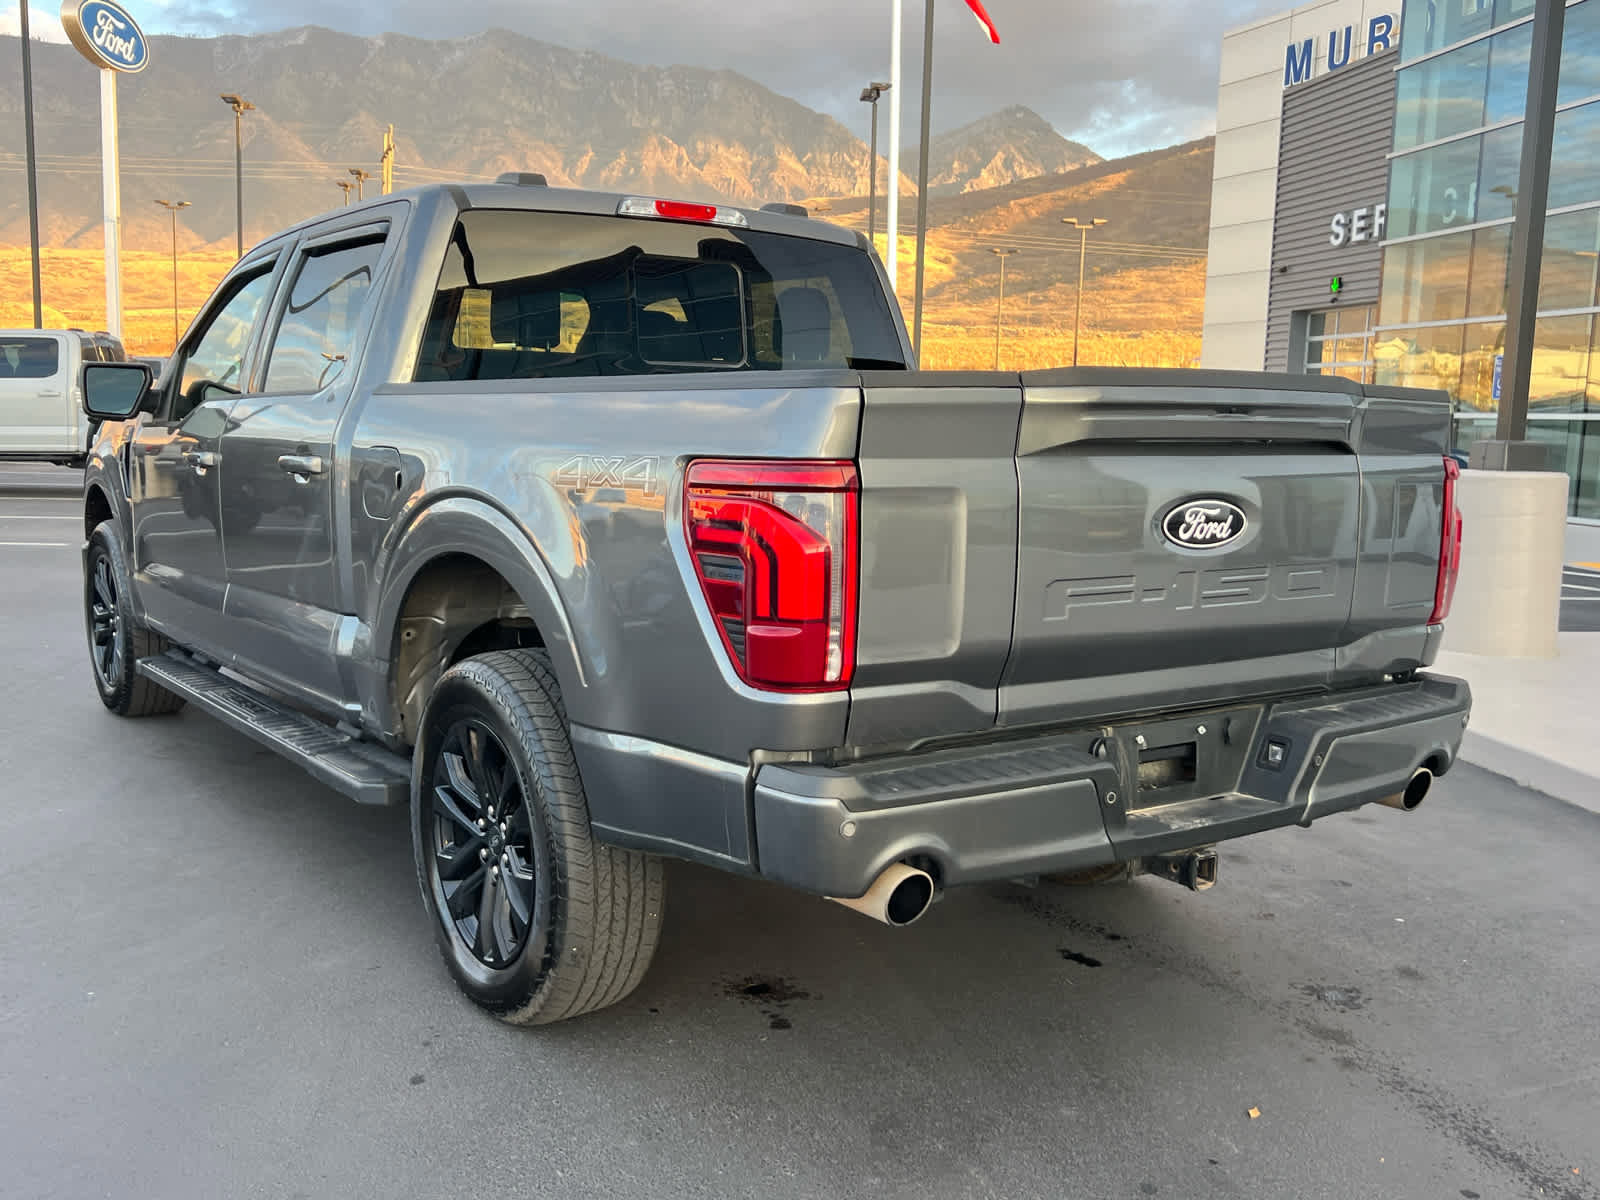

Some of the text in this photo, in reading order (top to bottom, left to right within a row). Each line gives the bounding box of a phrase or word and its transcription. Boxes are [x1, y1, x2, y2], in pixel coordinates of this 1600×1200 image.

[93, 9, 135, 61] Ford
[1179, 507, 1233, 540] Ford
[1043, 562, 1339, 622] F-150
